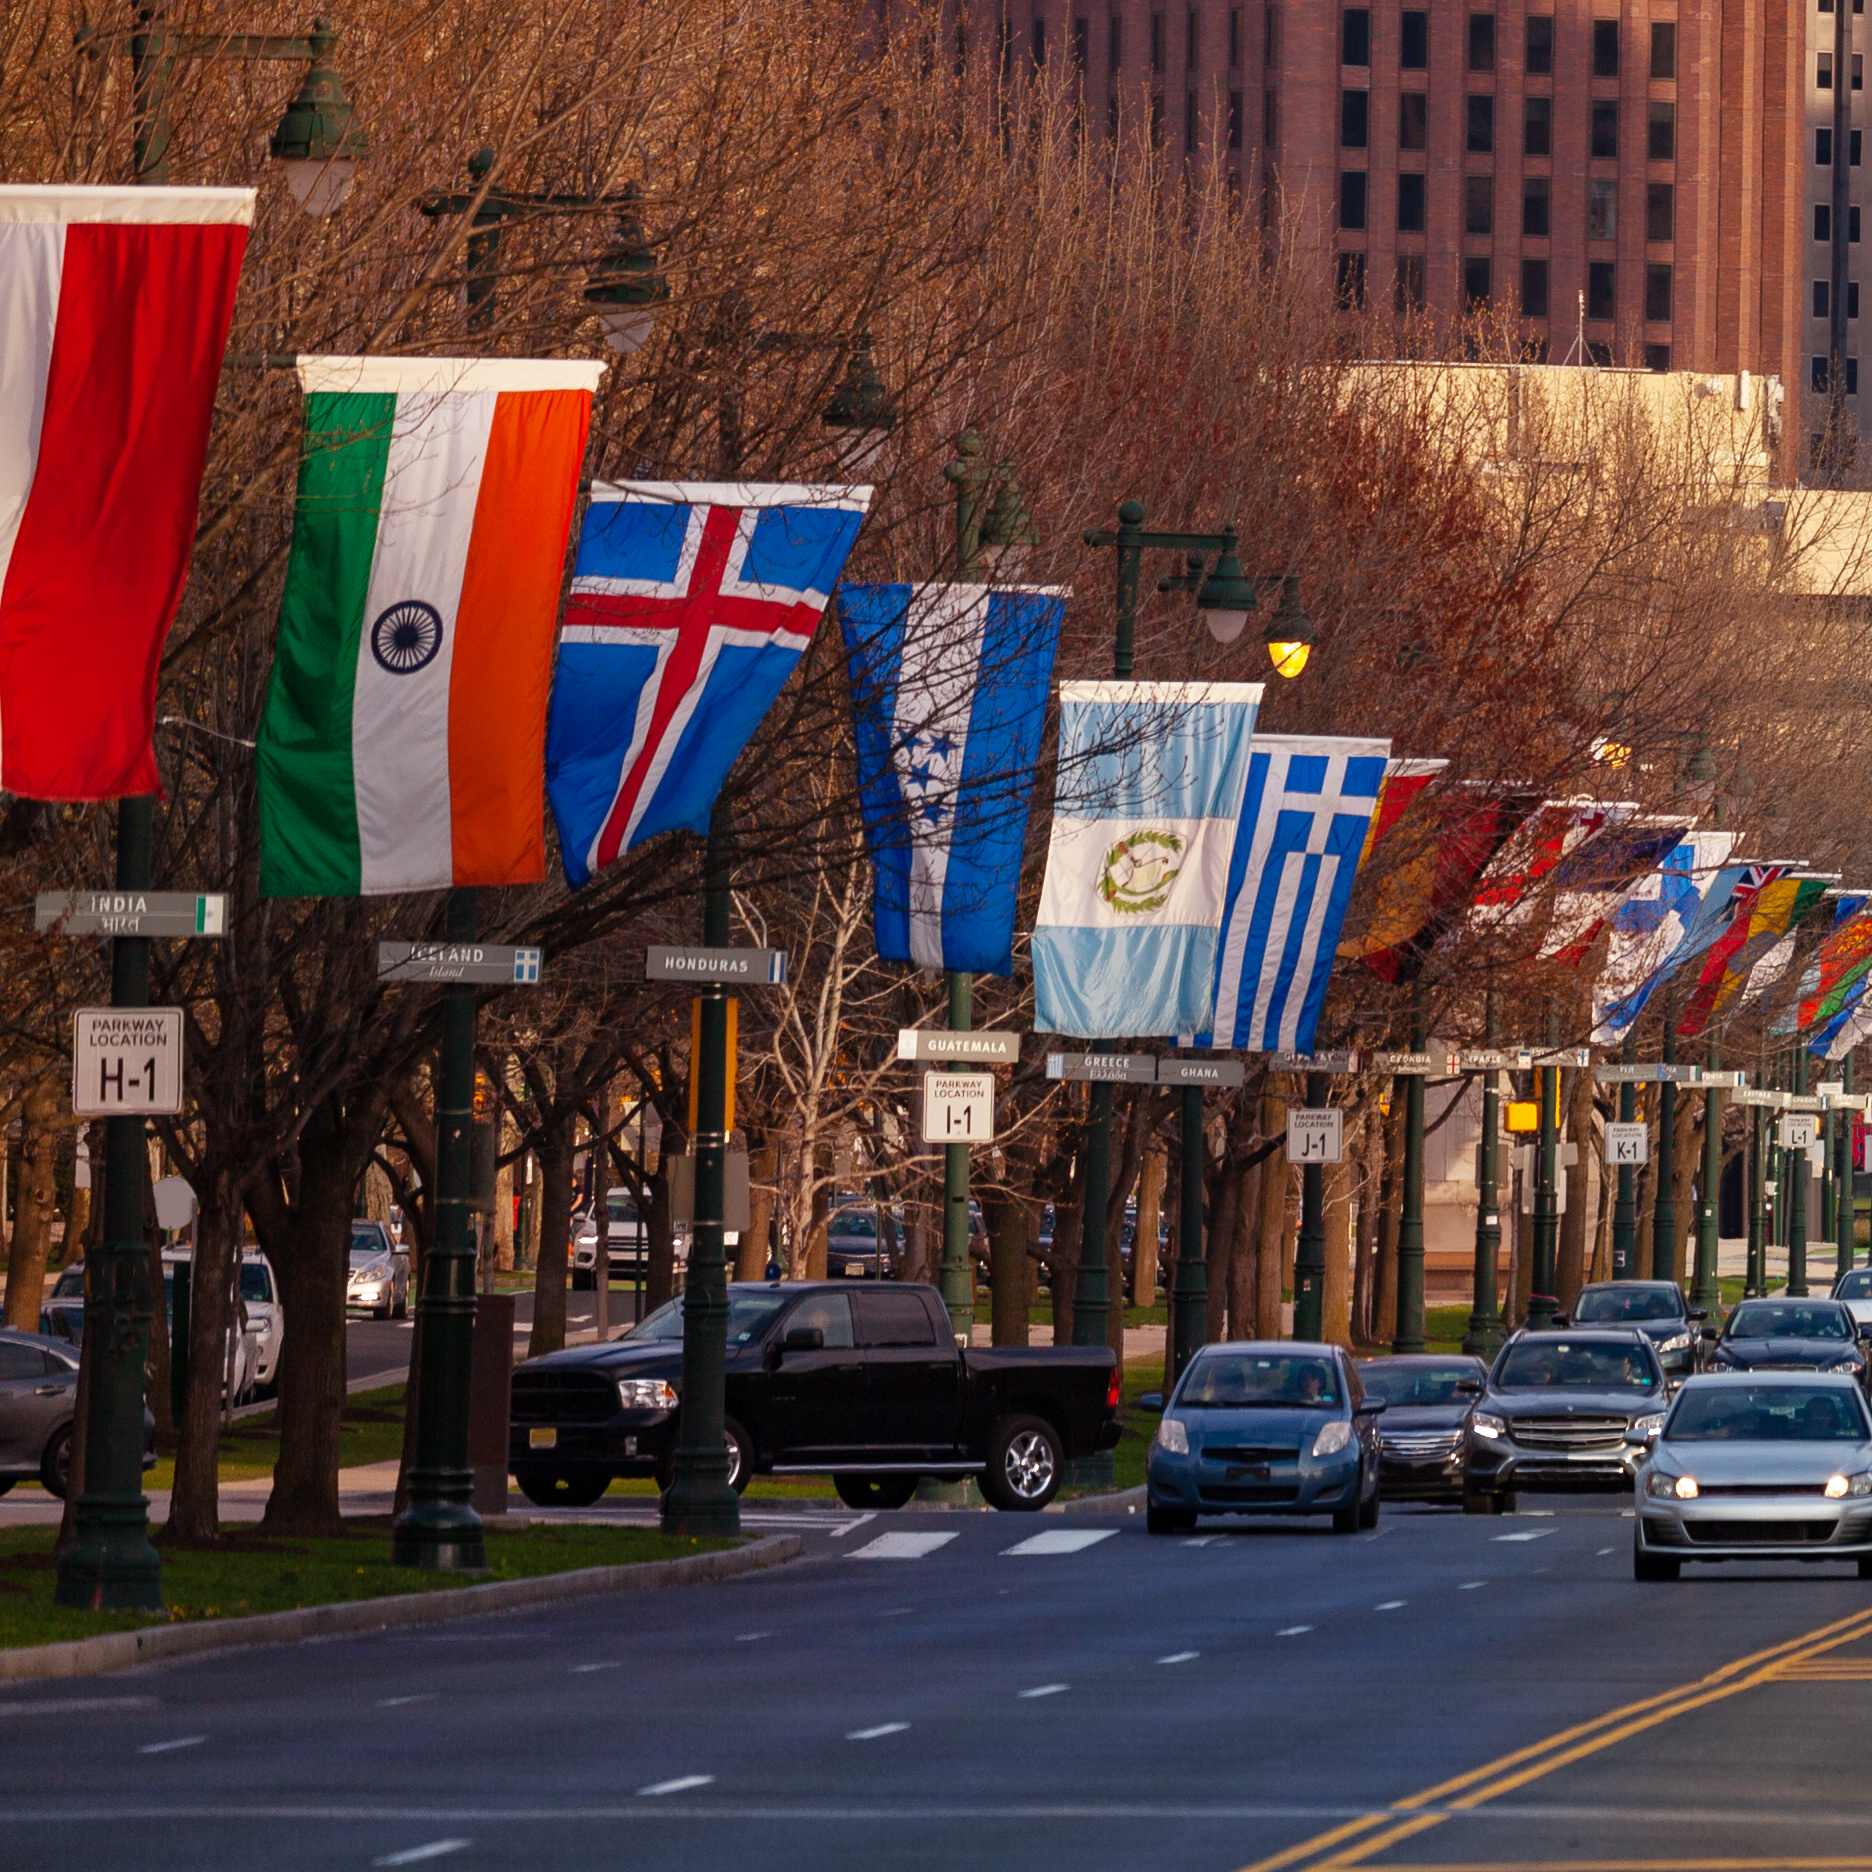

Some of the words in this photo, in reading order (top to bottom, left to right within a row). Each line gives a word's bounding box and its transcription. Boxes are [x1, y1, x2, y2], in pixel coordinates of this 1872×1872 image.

[91, 895, 148, 914] INDIA
[666, 956, 749, 973] HONDURAS
[92, 1018, 165, 1031] PARKWAY
[89, 1033, 167, 1047] LOCATION
[927, 1039, 1007, 1054] GUATEMALA
[1084, 1056, 1130, 1068] GREECE
[100, 1057, 156, 1103] H-1
[1181, 1067, 1219, 1079] GHANA
[935, 1080, 983, 1089] PARKWAY
[933, 1090, 985, 1099] LOCATION
[946, 1104, 973, 1135] I-1
[1295, 1113, 1333, 1121] PARKWAY
[1294, 1121, 1334, 1129] LOCATION
[1791, 1129, 1807, 1144] L-1
[1301, 1133, 1326, 1157] J-1
[1617, 1141, 1637, 1159] K-1
